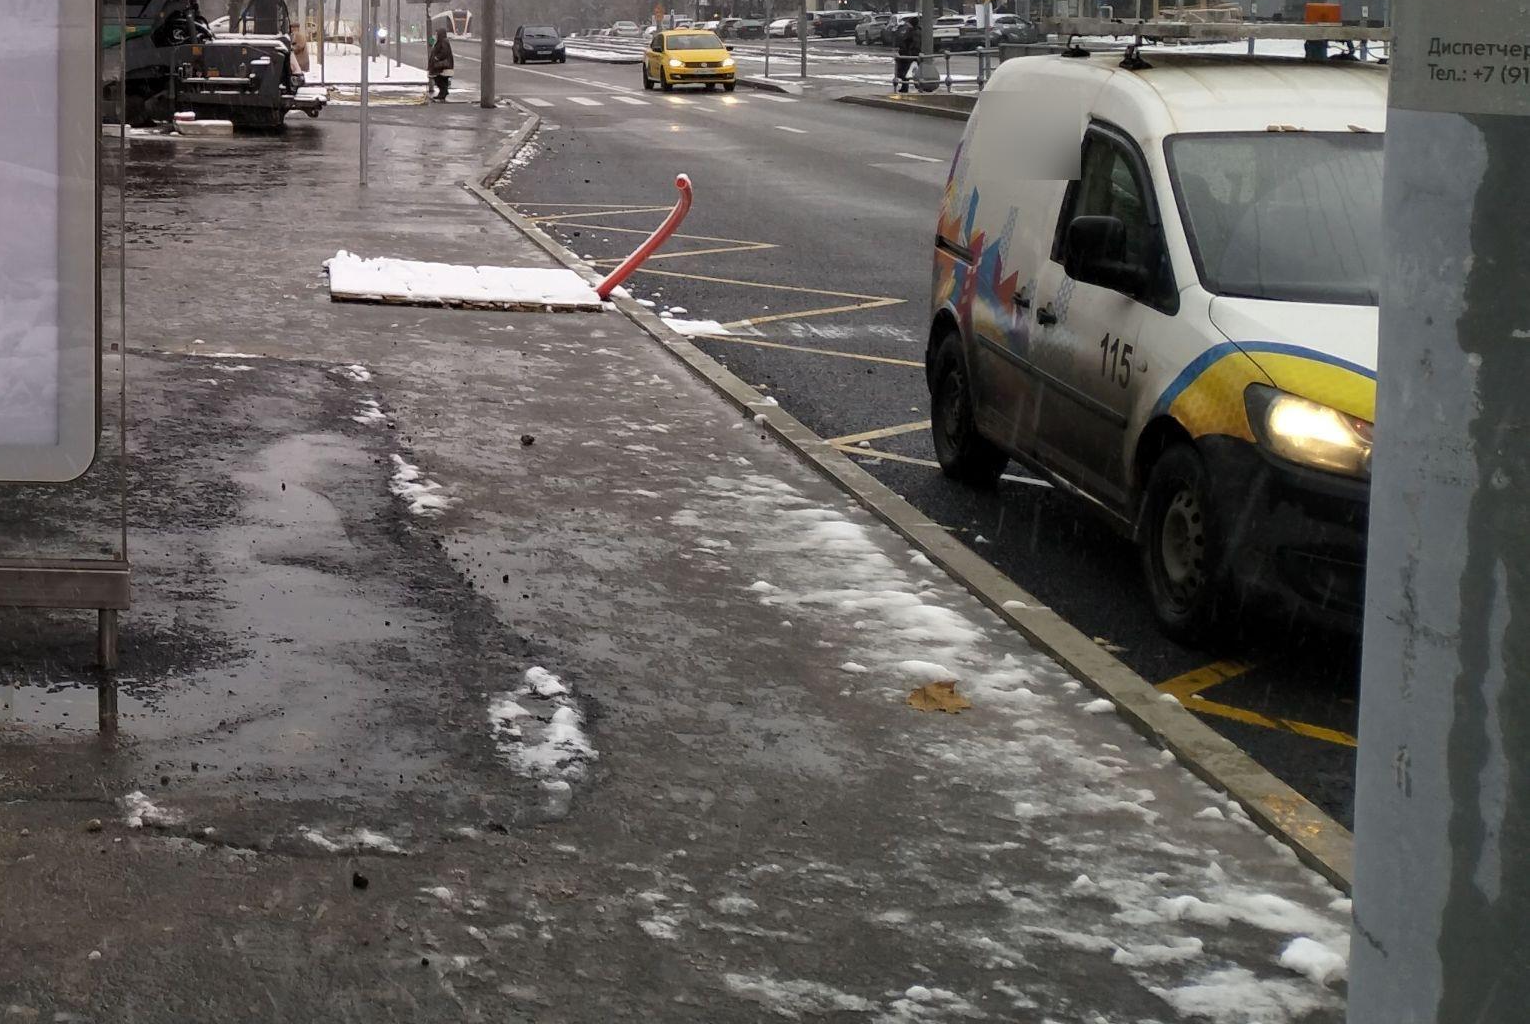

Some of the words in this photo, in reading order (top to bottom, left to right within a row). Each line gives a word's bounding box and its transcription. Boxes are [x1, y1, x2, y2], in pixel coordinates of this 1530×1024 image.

[1427, 63, 1468, 81] Тел.:
[1473, 65, 1495, 82] +7
[1100, 332, 1134, 389] 115
